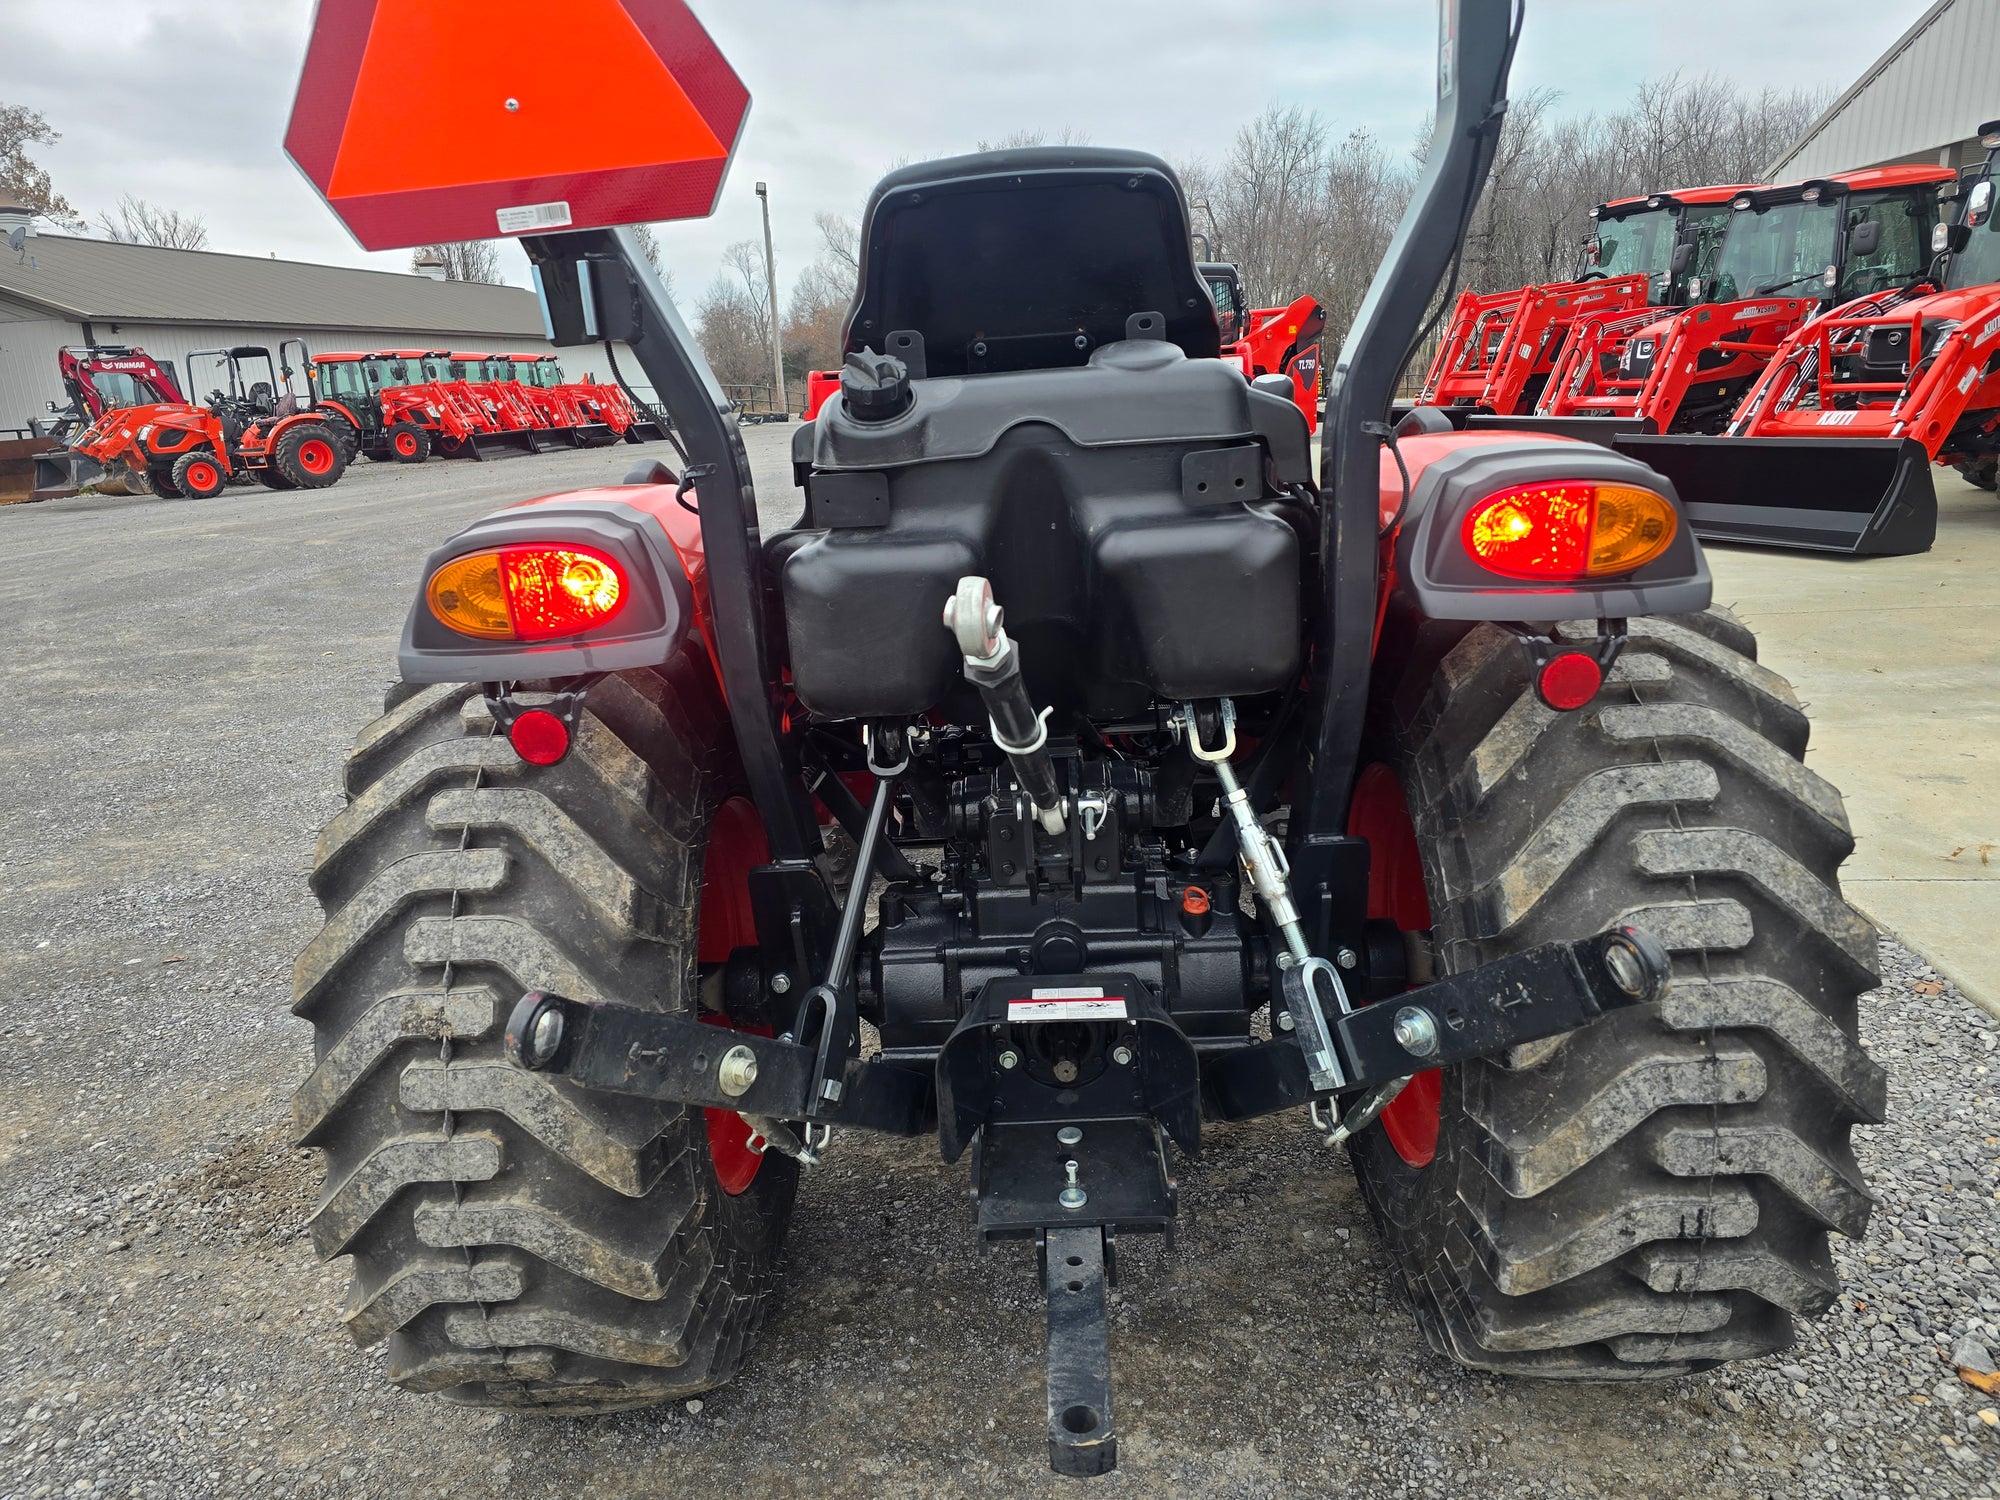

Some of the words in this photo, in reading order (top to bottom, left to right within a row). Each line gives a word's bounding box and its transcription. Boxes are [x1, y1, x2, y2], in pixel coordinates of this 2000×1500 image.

[114, 361, 146, 369] YANMAR
[1298, 359, 1316, 370] TL750
[1815, 410, 1859, 426] KIOTI
